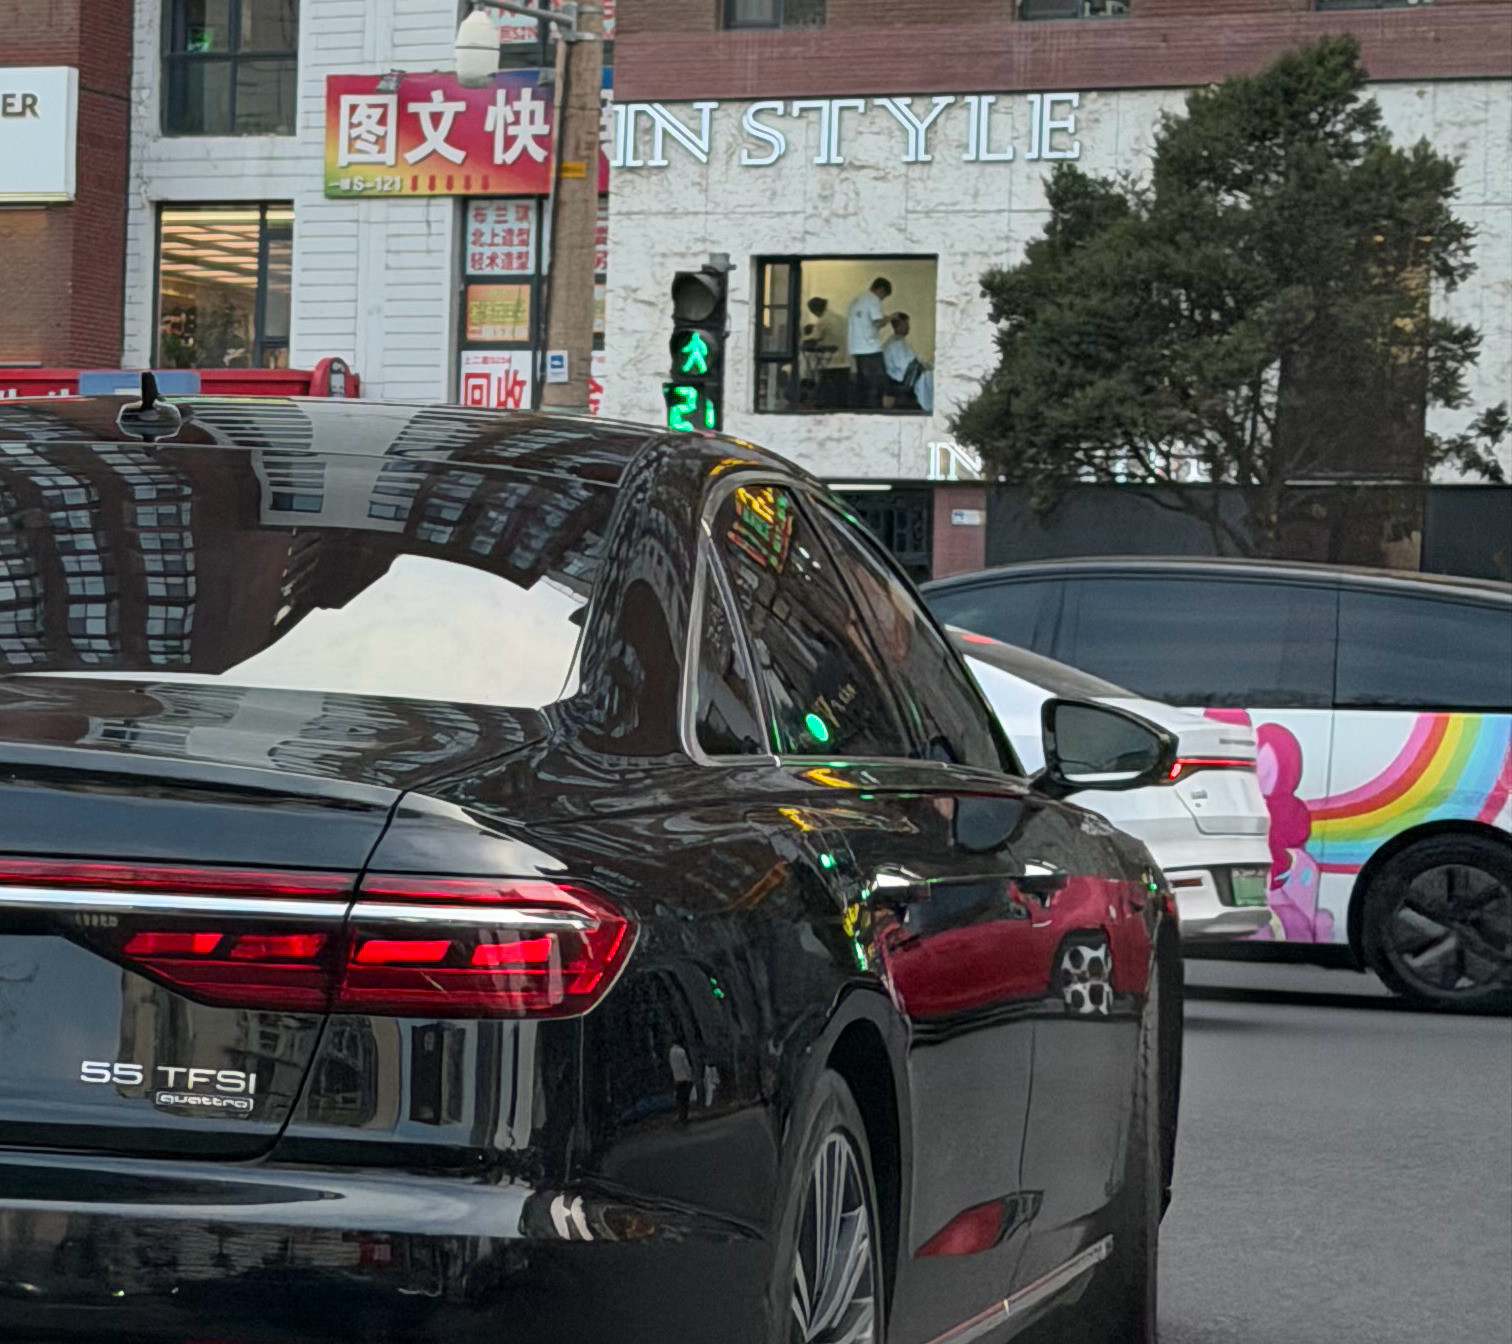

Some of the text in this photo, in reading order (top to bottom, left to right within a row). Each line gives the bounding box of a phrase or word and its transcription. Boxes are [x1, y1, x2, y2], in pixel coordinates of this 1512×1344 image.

[336, 86, 614, 169] 图文快
[464, 369, 527, 409] 回收
[80, 1060, 257, 1095] 55 TFSI
[159, 1092, 249, 1110] quattro
